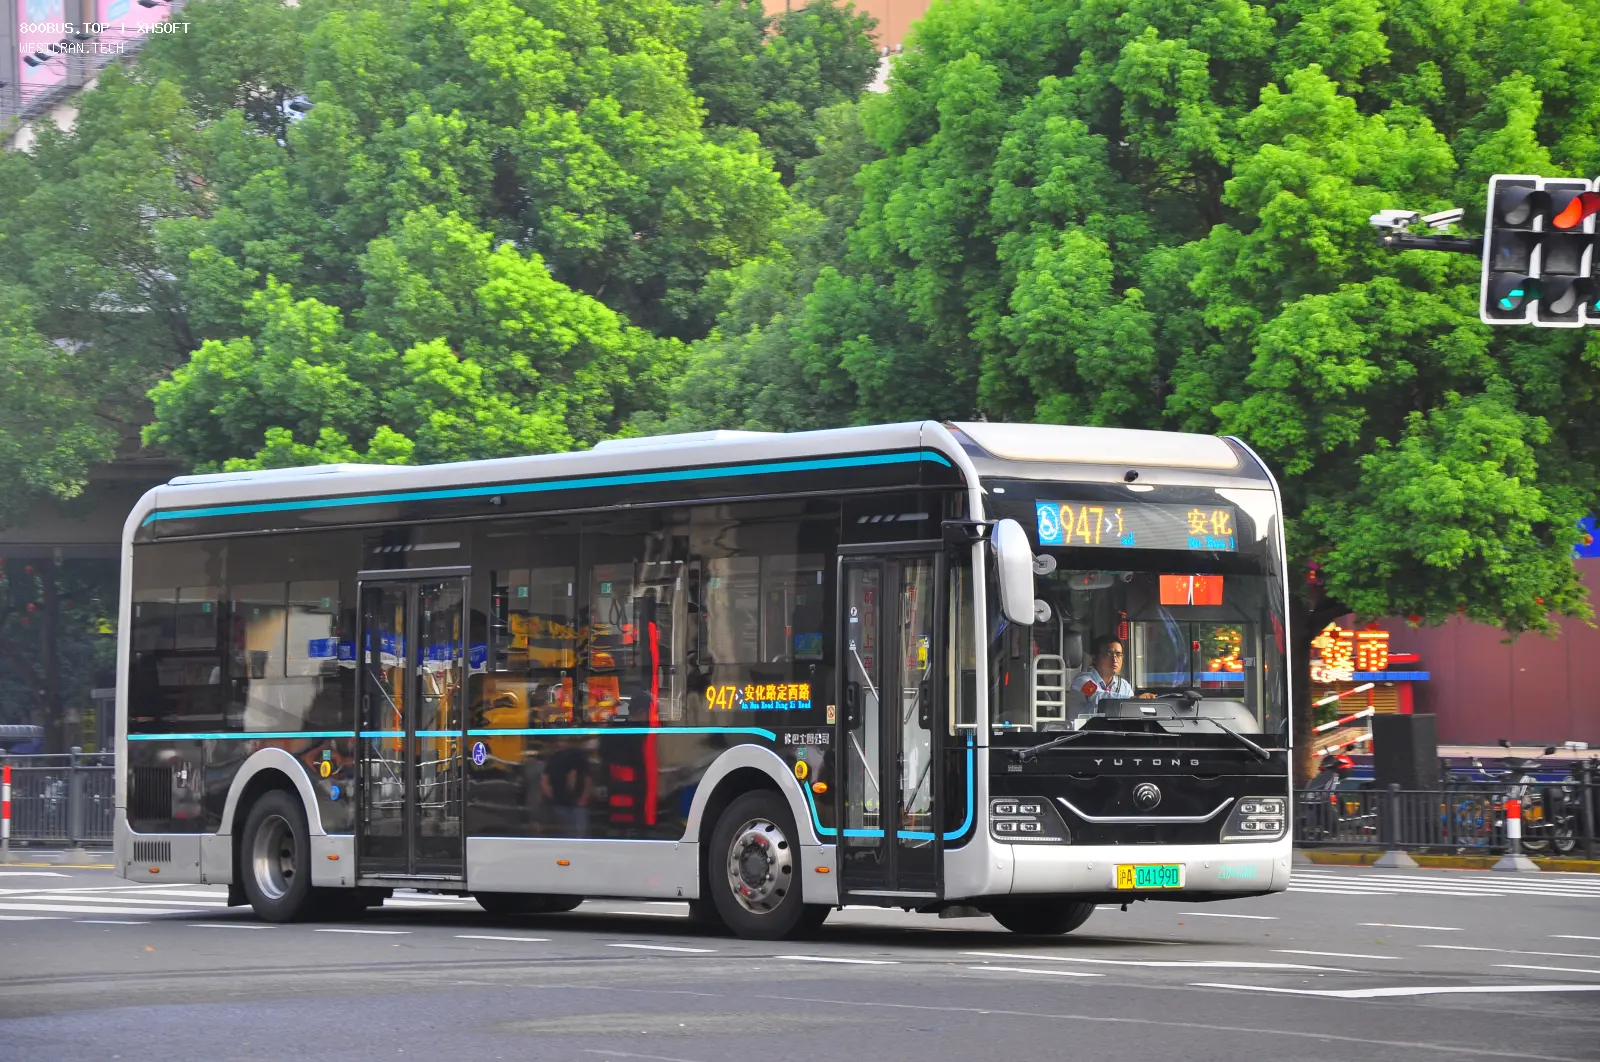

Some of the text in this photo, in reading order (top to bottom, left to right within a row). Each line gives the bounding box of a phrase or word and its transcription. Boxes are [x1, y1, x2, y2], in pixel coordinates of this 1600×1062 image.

[1059, 504, 1105, 545] 947
[1187, 508, 1233, 536] 安化
[706, 685, 737, 711] 947
[745, 683, 811, 701] 安化路定西路
[1093, 758, 1200, 767] YUTONG
